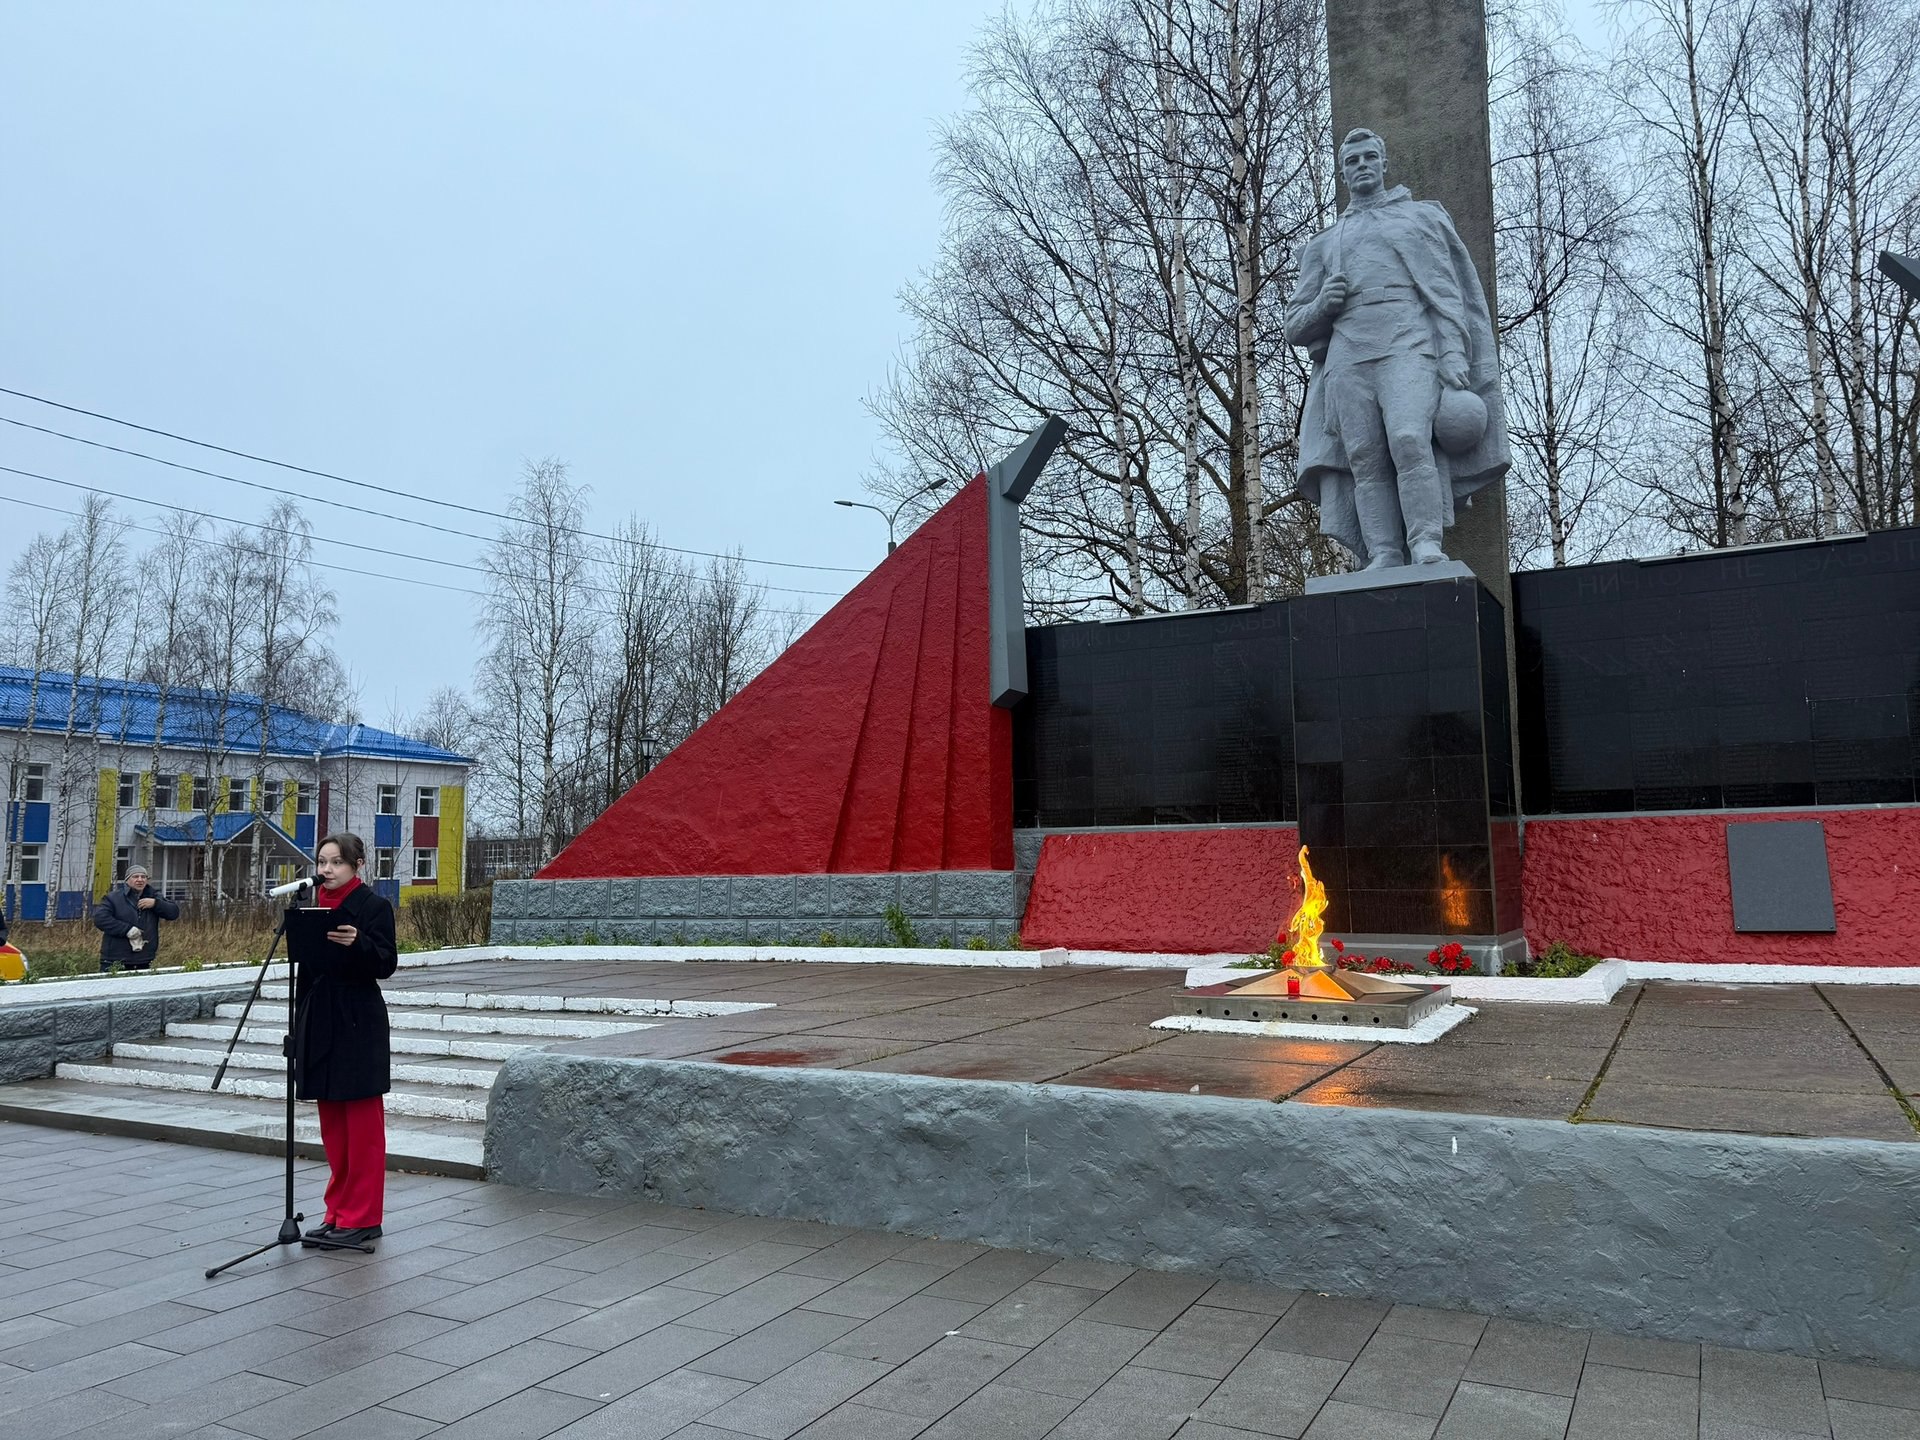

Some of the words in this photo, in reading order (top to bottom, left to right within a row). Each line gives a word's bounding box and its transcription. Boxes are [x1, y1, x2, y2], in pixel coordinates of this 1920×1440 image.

[1578, 568, 1682, 597] НИЧТО
[1721, 557, 1764, 580] НЕ
[1062, 626, 1131, 649] НИКТО
[1160, 620, 1190, 640] НЕ
[1215, 611, 1289, 634] ЗАБЫ
